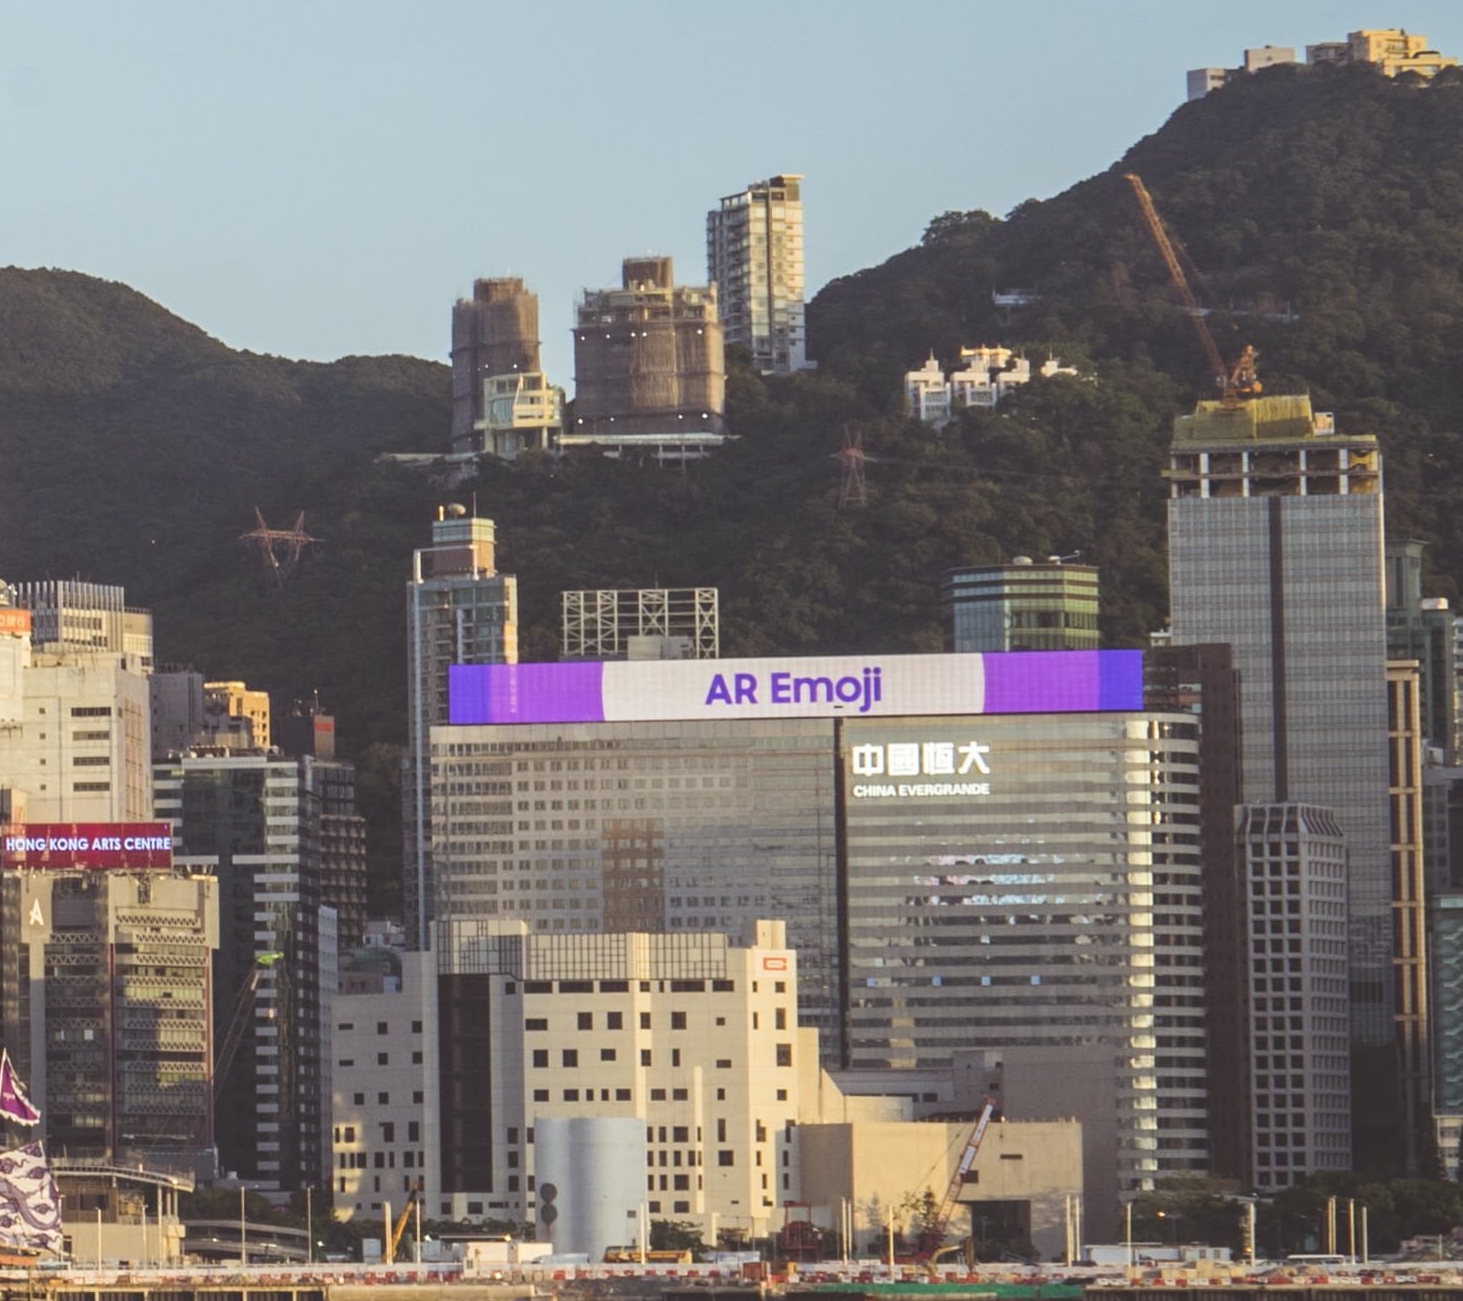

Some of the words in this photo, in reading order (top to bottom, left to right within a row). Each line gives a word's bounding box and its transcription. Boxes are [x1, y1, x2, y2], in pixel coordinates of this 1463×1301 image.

[705, 673, 758, 705] AR
[771, 667, 882, 713] Emoji
[853, 784, 897, 797] CHINA
[898, 783, 990, 796] EVERGRANDE
[6, 838, 46, 851] HONG
[49, 838, 89, 851] KONG
[92, 838, 122, 851] ARTS
[124, 837, 171, 851] CENTRE
